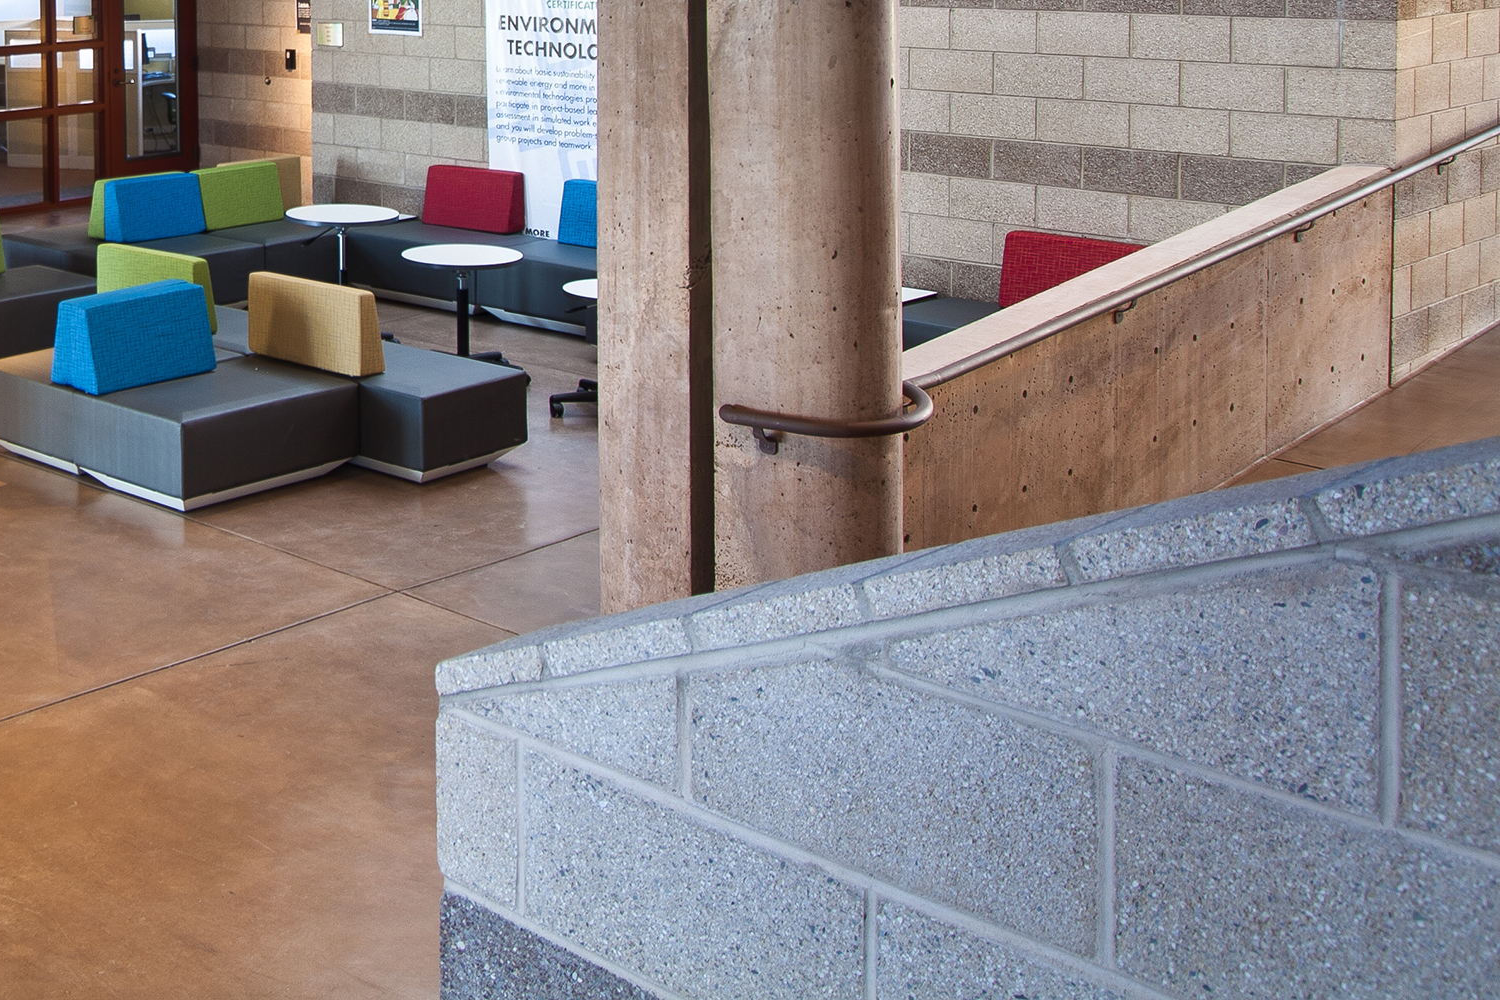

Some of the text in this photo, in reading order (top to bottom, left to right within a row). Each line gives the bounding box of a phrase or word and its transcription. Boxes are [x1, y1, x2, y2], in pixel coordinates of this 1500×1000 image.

[546, 0, 597, 10] CERTIFICAT
[499, 15, 597, 34] ENVIRONM
[515, 66, 532, 74] about
[535, 67, 551, 76] basic
[553, 70, 595, 81] sustainability
[530, 81, 552, 90] energy
[554, 81, 567, 89] and
[496, 88, 540, 99] environmental
[542, 92, 583, 104] technologies
[496, 100, 529, 112] participate
[541, 104, 585, 114] project-based
[496, 112, 530, 120] assessment
[541, 115, 571, 125] simulated
[573, 118, 590, 126] work
[524, 124, 535, 132] will
[537, 125, 562, 136] develop
[496, 135, 516, 144] group
[518, 137, 542, 146] projects
[559, 140, 593, 150] teamwork.
[525, 228, 550, 238] MORE
